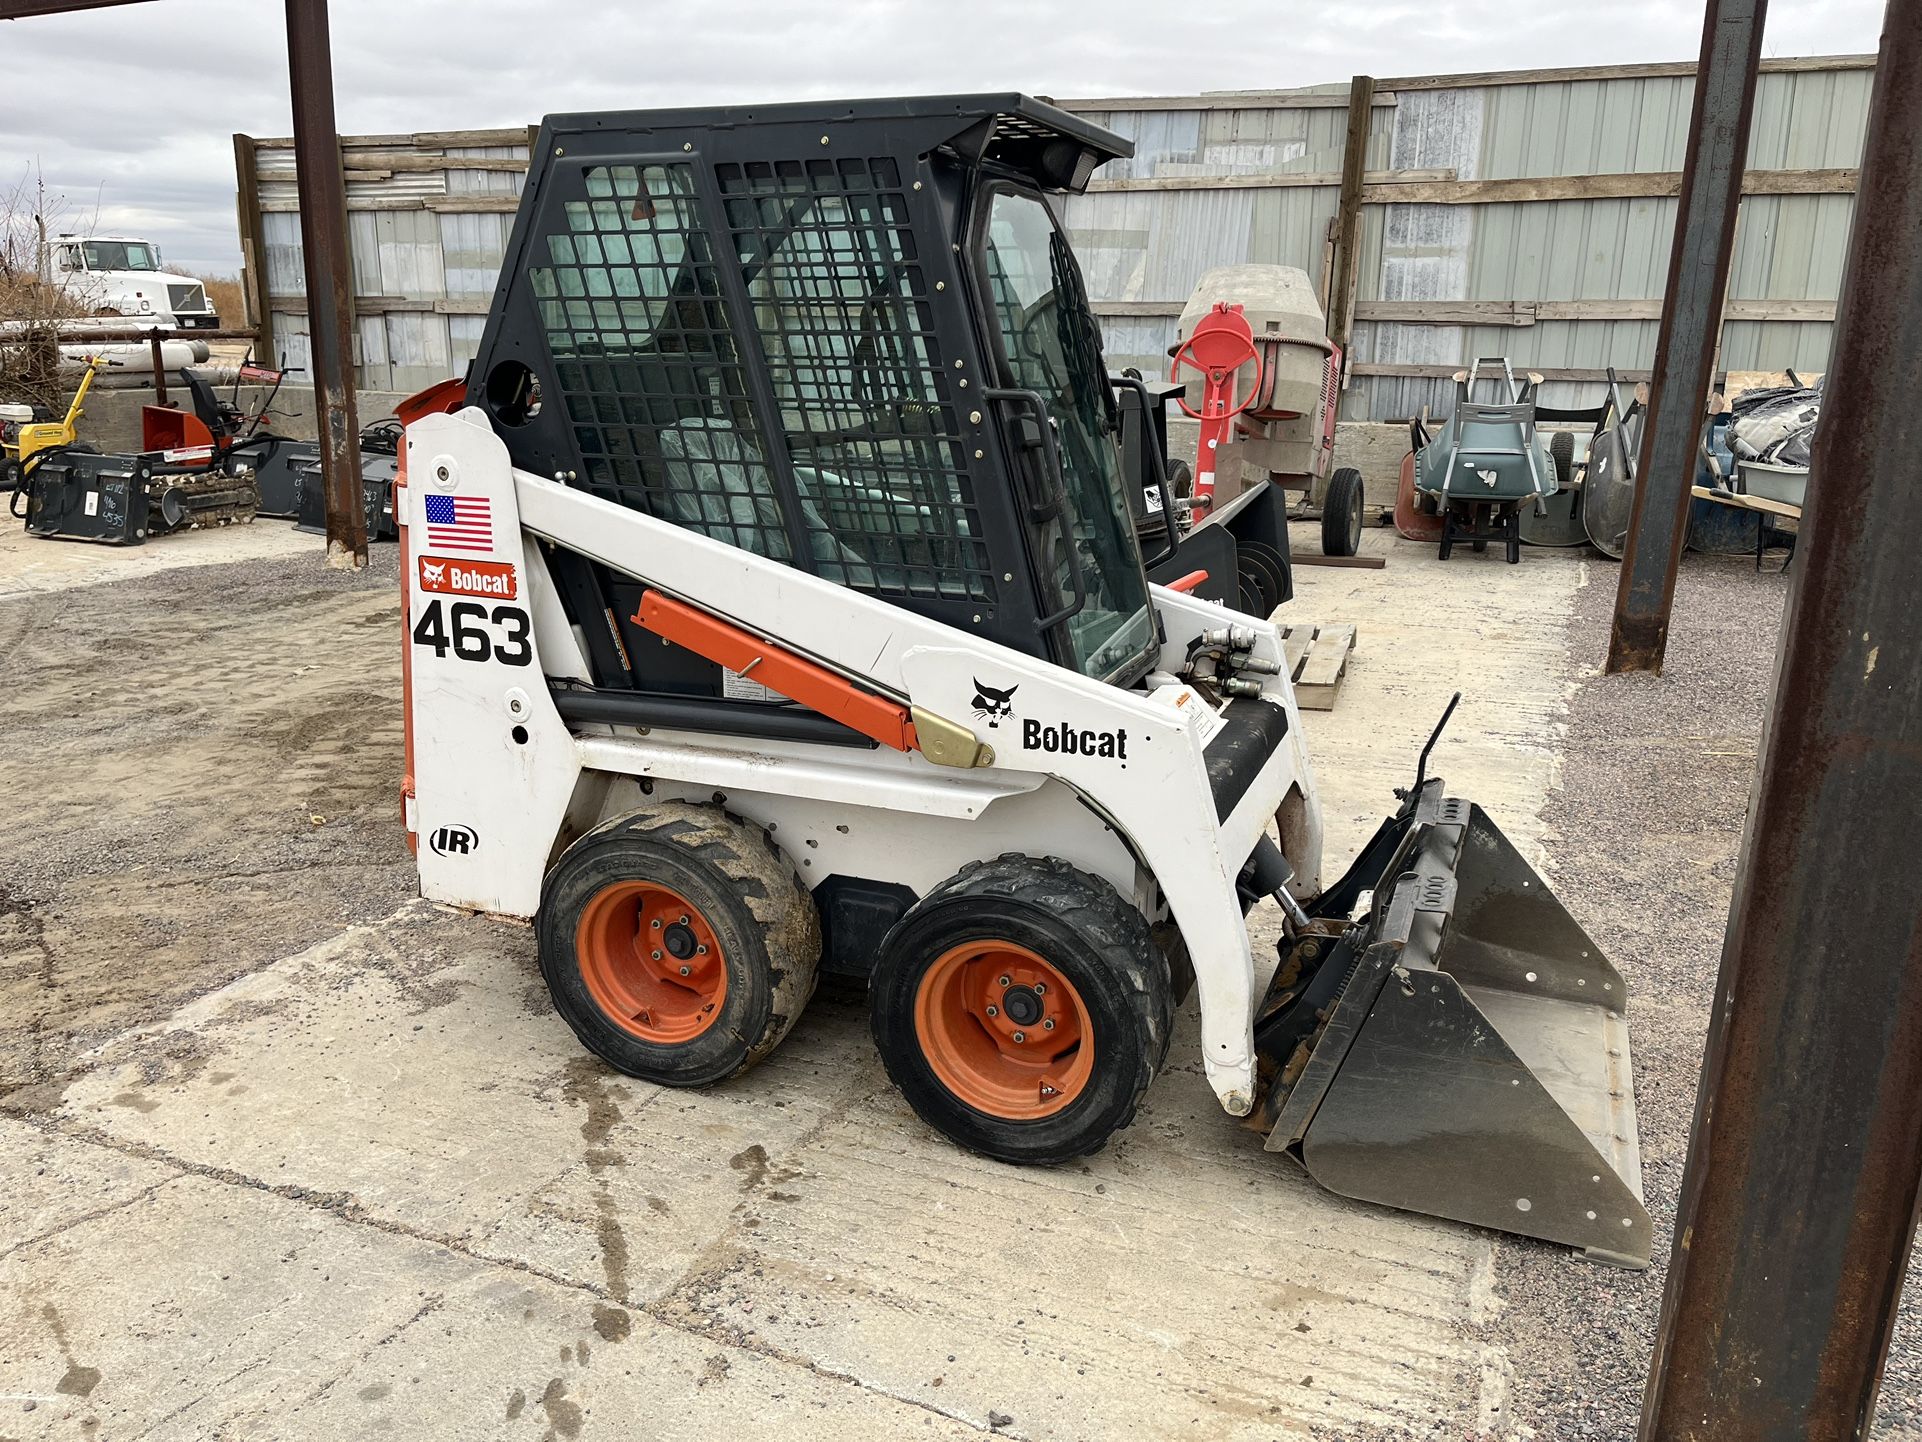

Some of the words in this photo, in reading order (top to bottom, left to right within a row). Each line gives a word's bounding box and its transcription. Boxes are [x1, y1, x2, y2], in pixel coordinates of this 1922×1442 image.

[450, 567, 510, 595] Bobcat
[413, 599, 533, 667] 463
[1023, 718, 1128, 760] Bobcat
[437, 827, 471, 855] IR
